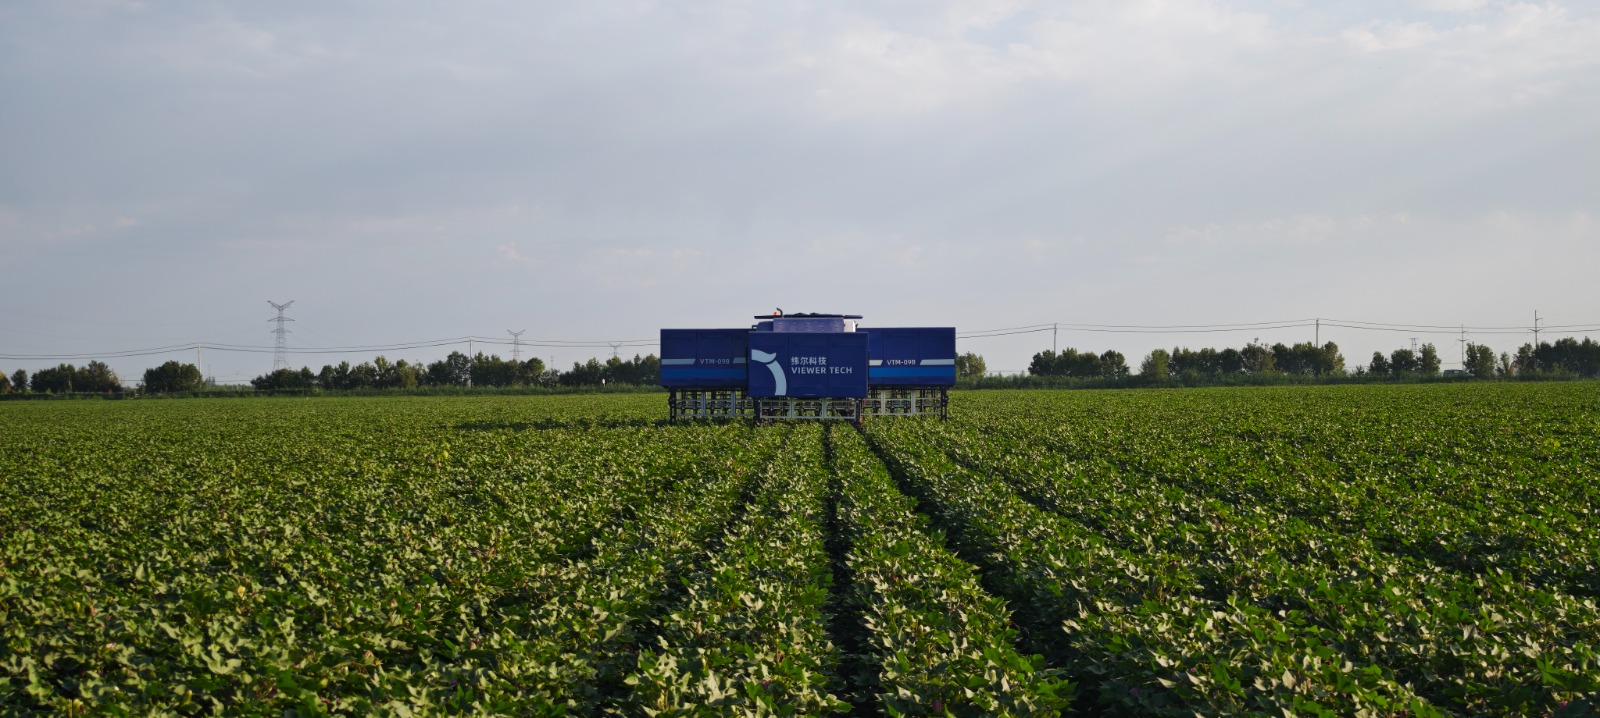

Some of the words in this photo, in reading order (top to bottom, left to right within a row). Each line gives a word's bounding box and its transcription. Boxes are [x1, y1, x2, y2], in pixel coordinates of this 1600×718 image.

[791, 356, 827, 365] 纬尔科技
[791, 366, 827, 374] VIEWER
[829, 366, 853, 374] TECH
